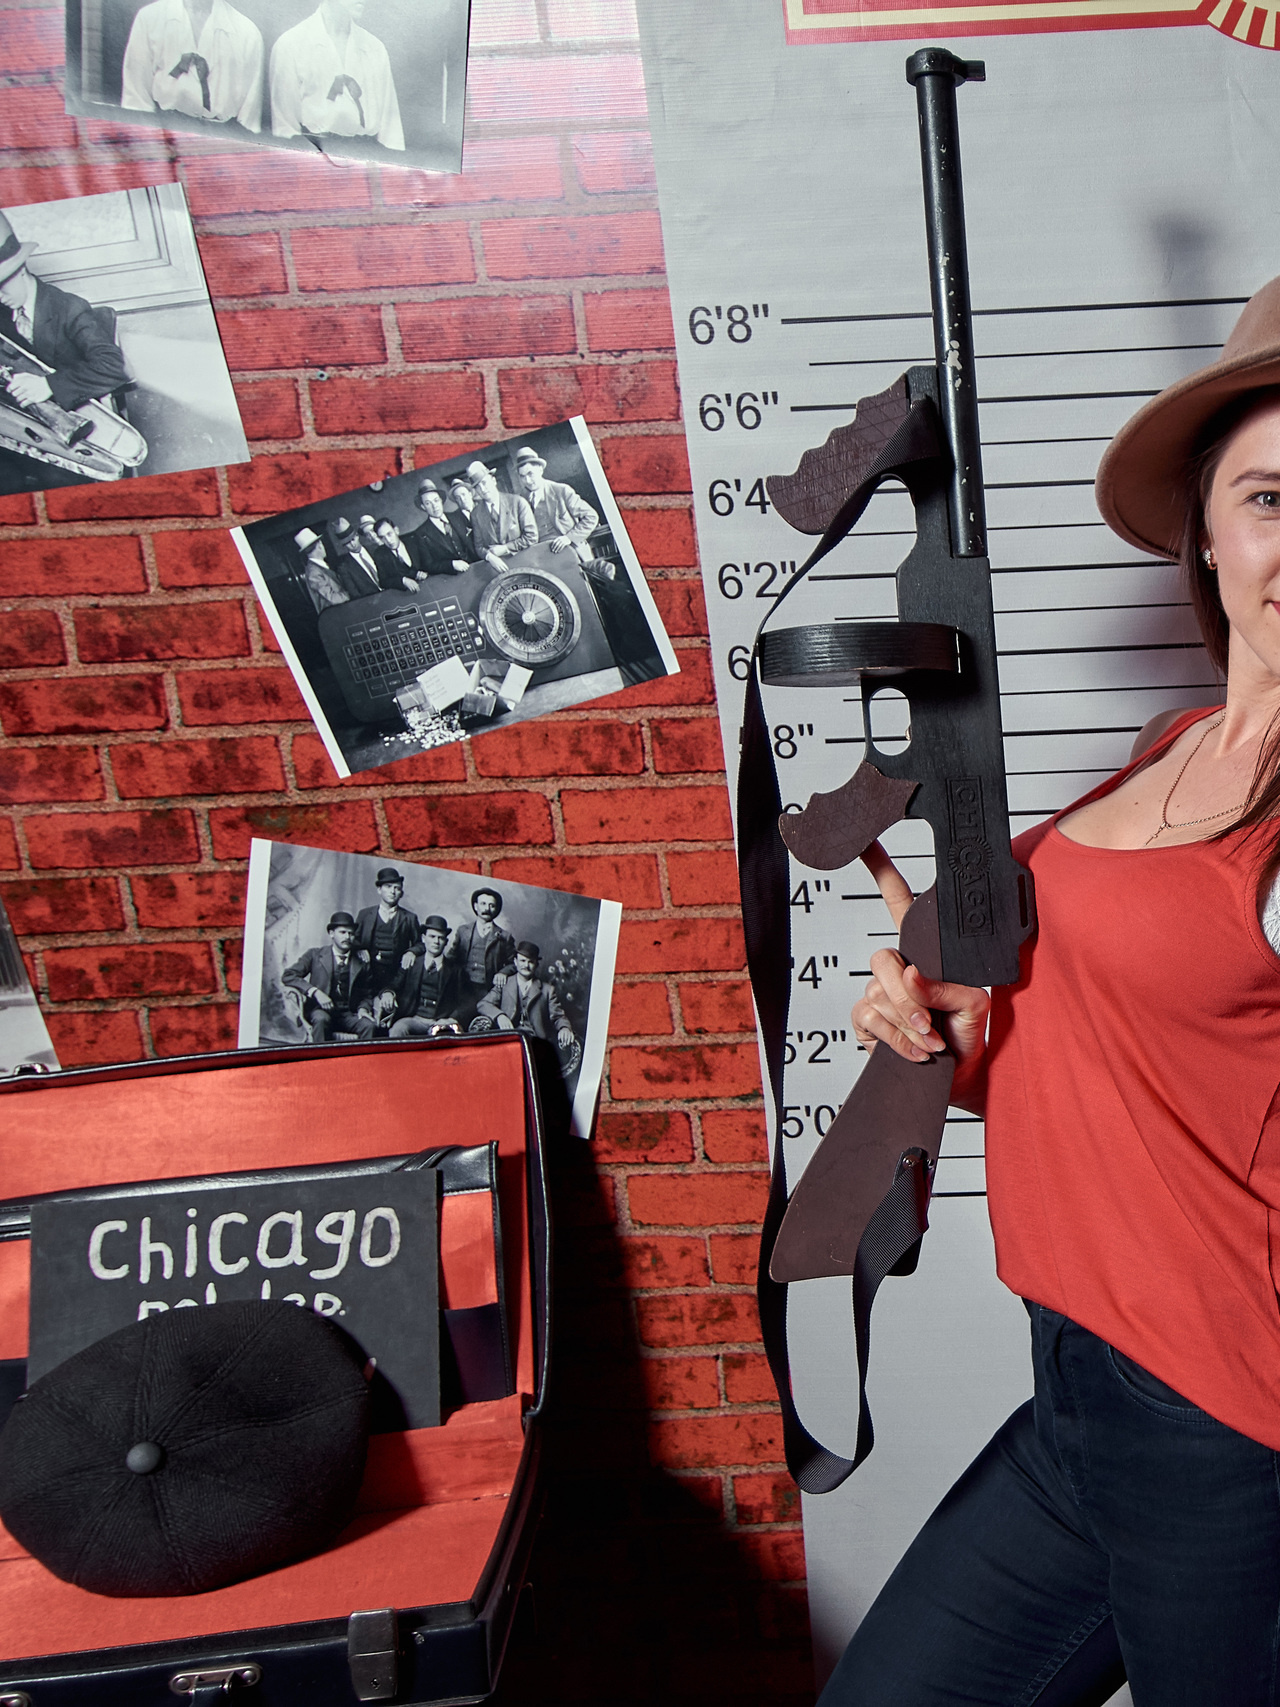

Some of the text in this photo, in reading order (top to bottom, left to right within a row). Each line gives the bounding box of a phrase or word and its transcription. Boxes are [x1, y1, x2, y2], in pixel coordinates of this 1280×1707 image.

[688, 303, 769, 345] 6'8"
[698, 391, 779, 432] 6'6"
[708, 478, 771, 516] 6'4
[954, 785, 988, 931] CHICAGO
[782, 1104, 842, 1139] 5'0
[88, 1206, 400, 1284] Chicago
